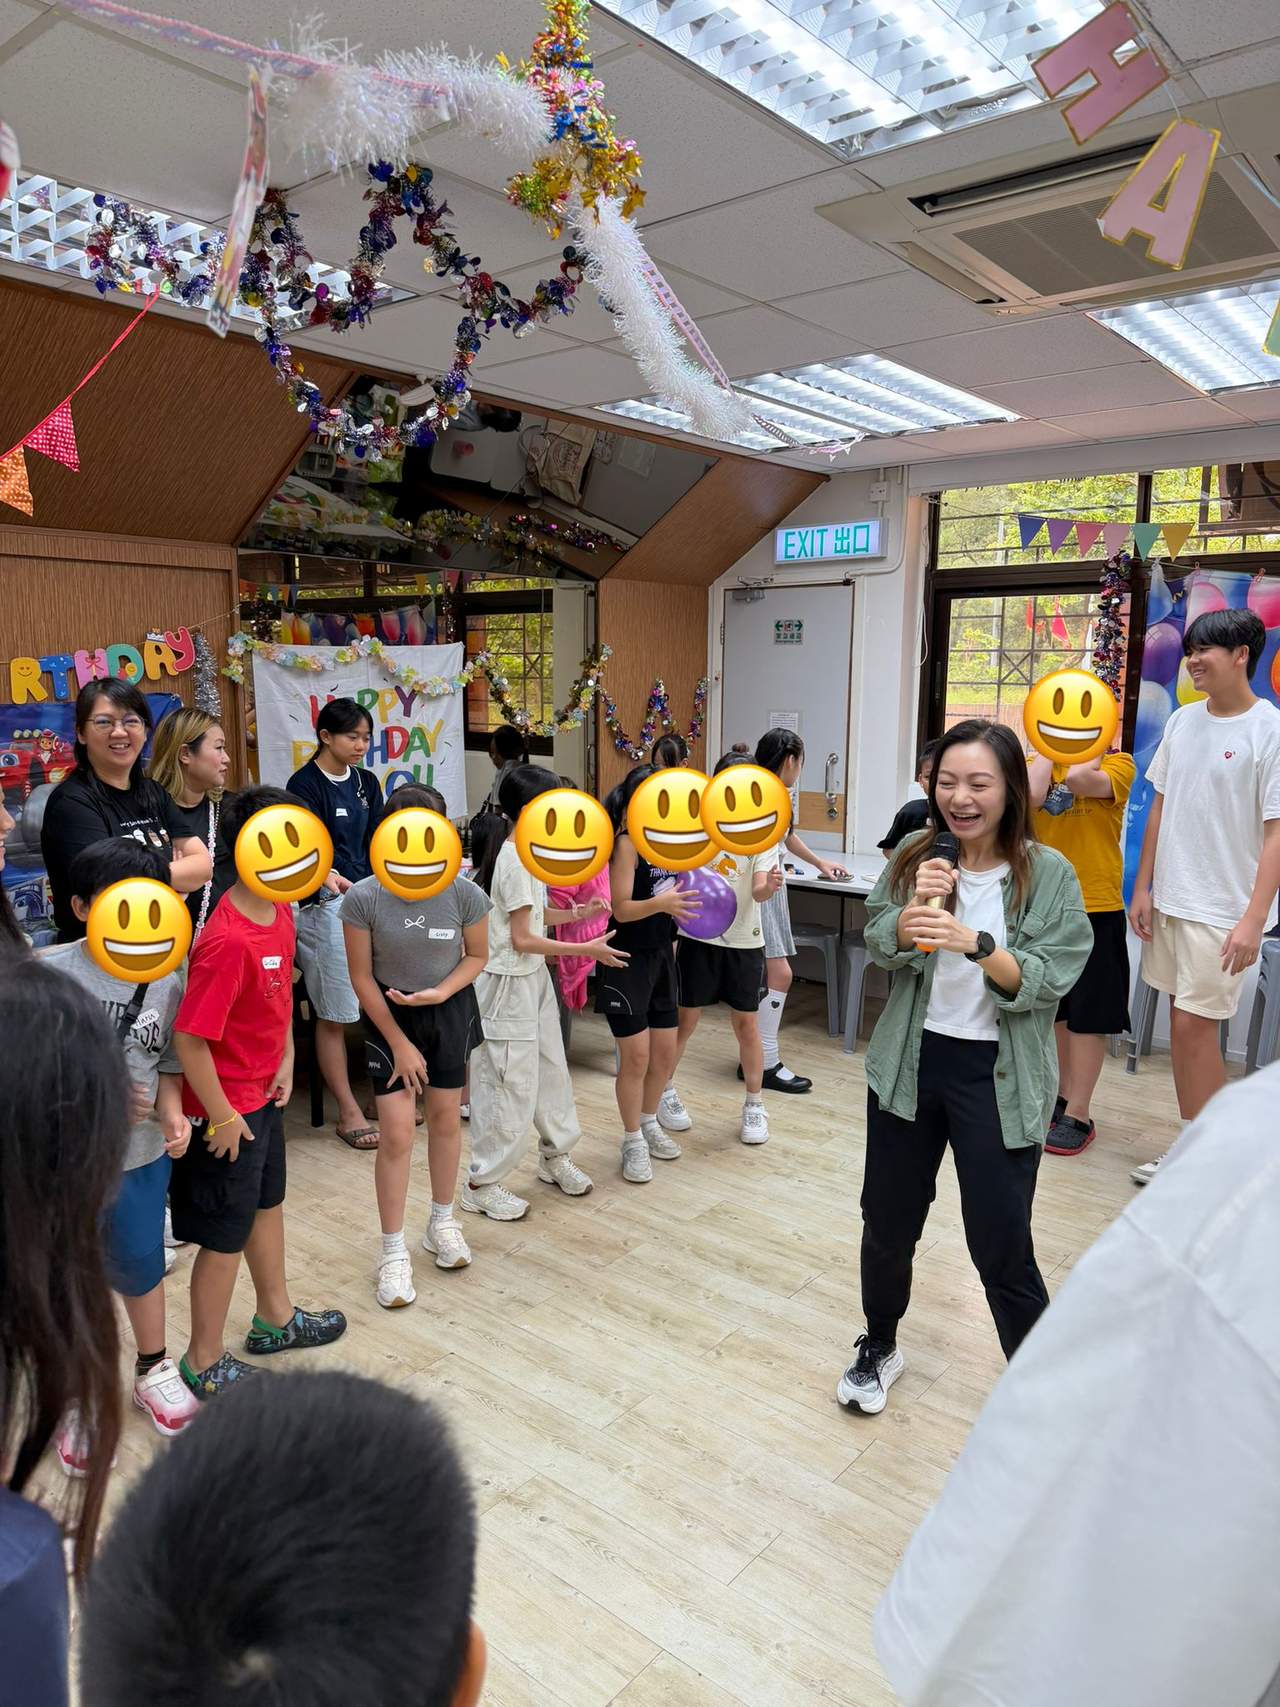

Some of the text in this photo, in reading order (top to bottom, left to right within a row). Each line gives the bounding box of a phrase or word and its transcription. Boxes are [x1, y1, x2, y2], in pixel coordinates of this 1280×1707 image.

[784, 525, 869, 559] EXIT 出口
[309, 686, 418, 729] HPPY
